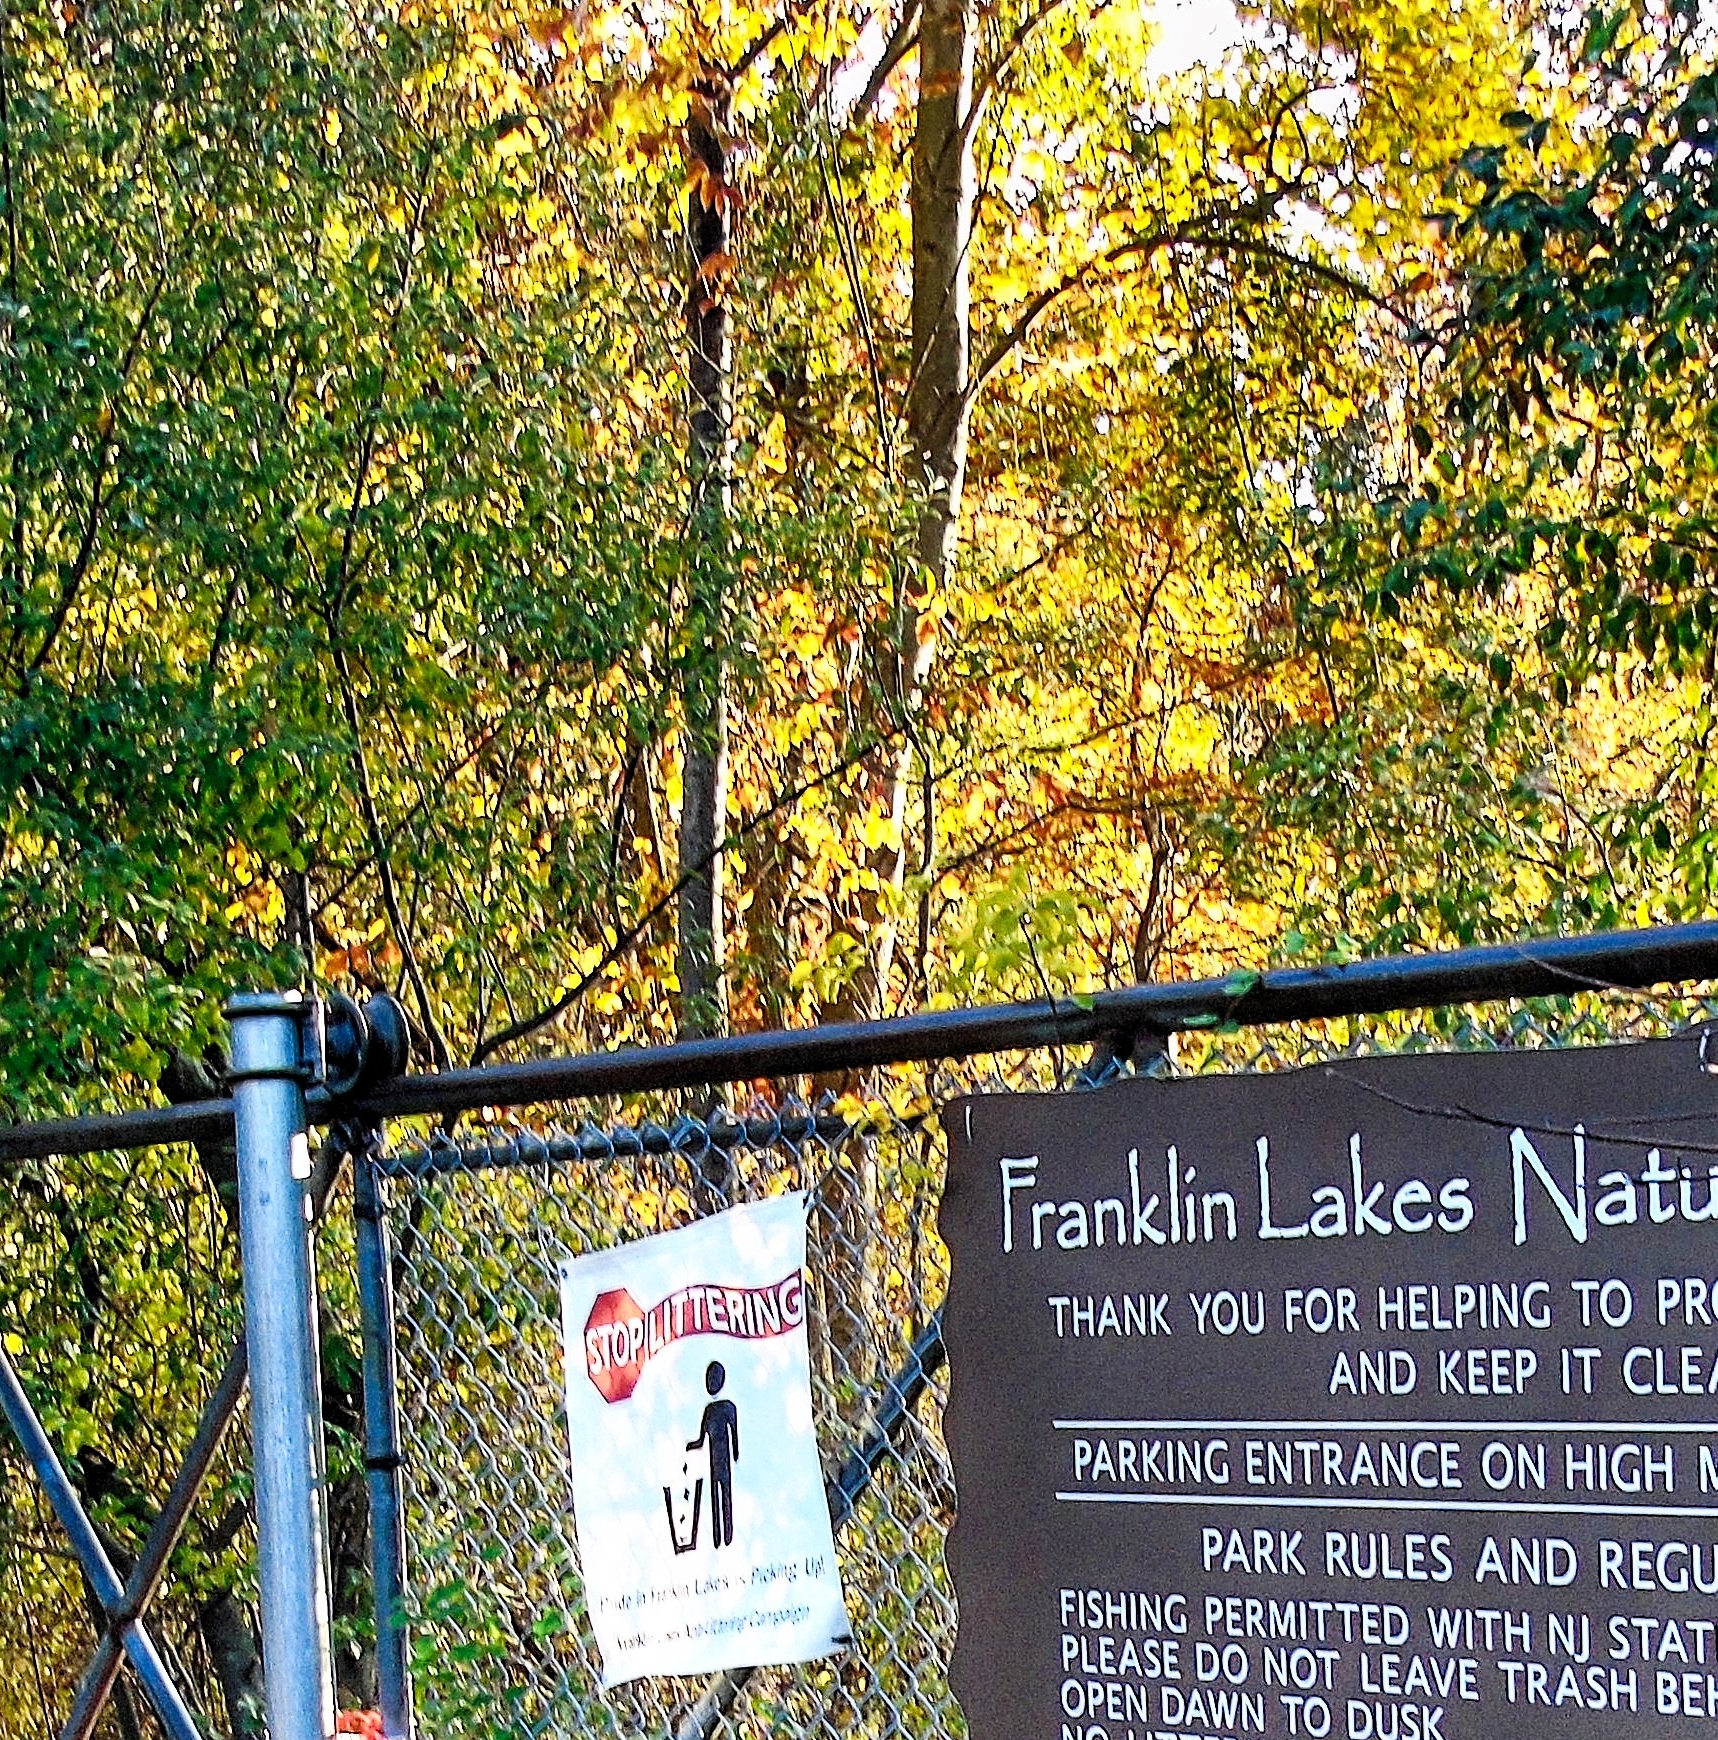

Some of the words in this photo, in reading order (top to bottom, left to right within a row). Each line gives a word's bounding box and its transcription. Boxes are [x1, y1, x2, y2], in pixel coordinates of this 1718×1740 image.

[1000, 1145, 1236, 1252] Franklin
[1256, 1133, 1473, 1238] Lakes
[649, 1276, 802, 1354] LITTERING
[1048, 1294, 1171, 1337] THANK
[1189, 1291, 1264, 1334] YOU
[1285, 1288, 1360, 1333] FOR
[1379, 1282, 1550, 1330] HELPING
[1571, 1279, 1632, 1327] TO
[584, 1318, 646, 1376] STOP
[1330, 1351, 1416, 1394] AND
[1439, 1349, 1537, 1394] KEEP
[1562, 1348, 1601, 1393] IT
[1075, 1440, 1229, 1483] PARKING
[1246, 1441, 1462, 1487] ENTRANCE
[1482, 1442, 1545, 1489] ON
[1566, 1444, 1673, 1492] HIGH
[1203, 1528, 1305, 1575] PARK
[1326, 1532, 1452, 1581] RULES
[1476, 1537, 1577, 1585] AND
[1061, 1589, 1187, 1633] FISHING
[1206, 1597, 1409, 1645] PERMITTED
[1427, 1607, 1530, 1653] WITH
[1549, 1613, 1589, 1663] NJ
[1062, 1634, 1181, 1679] PLEASE
[1196, 1643, 1248, 1684] DO
[1264, 1647, 1340, 1689] NOT
[1361, 1653, 1479, 1700] LEAVE
[1498, 1661, 1636, 1711] TRASH
[1062, 1679, 1147, 1722] OPEN
[1162, 1687, 1264, 1732] DAWN
[1280, 1695, 1330, 1737] TO
